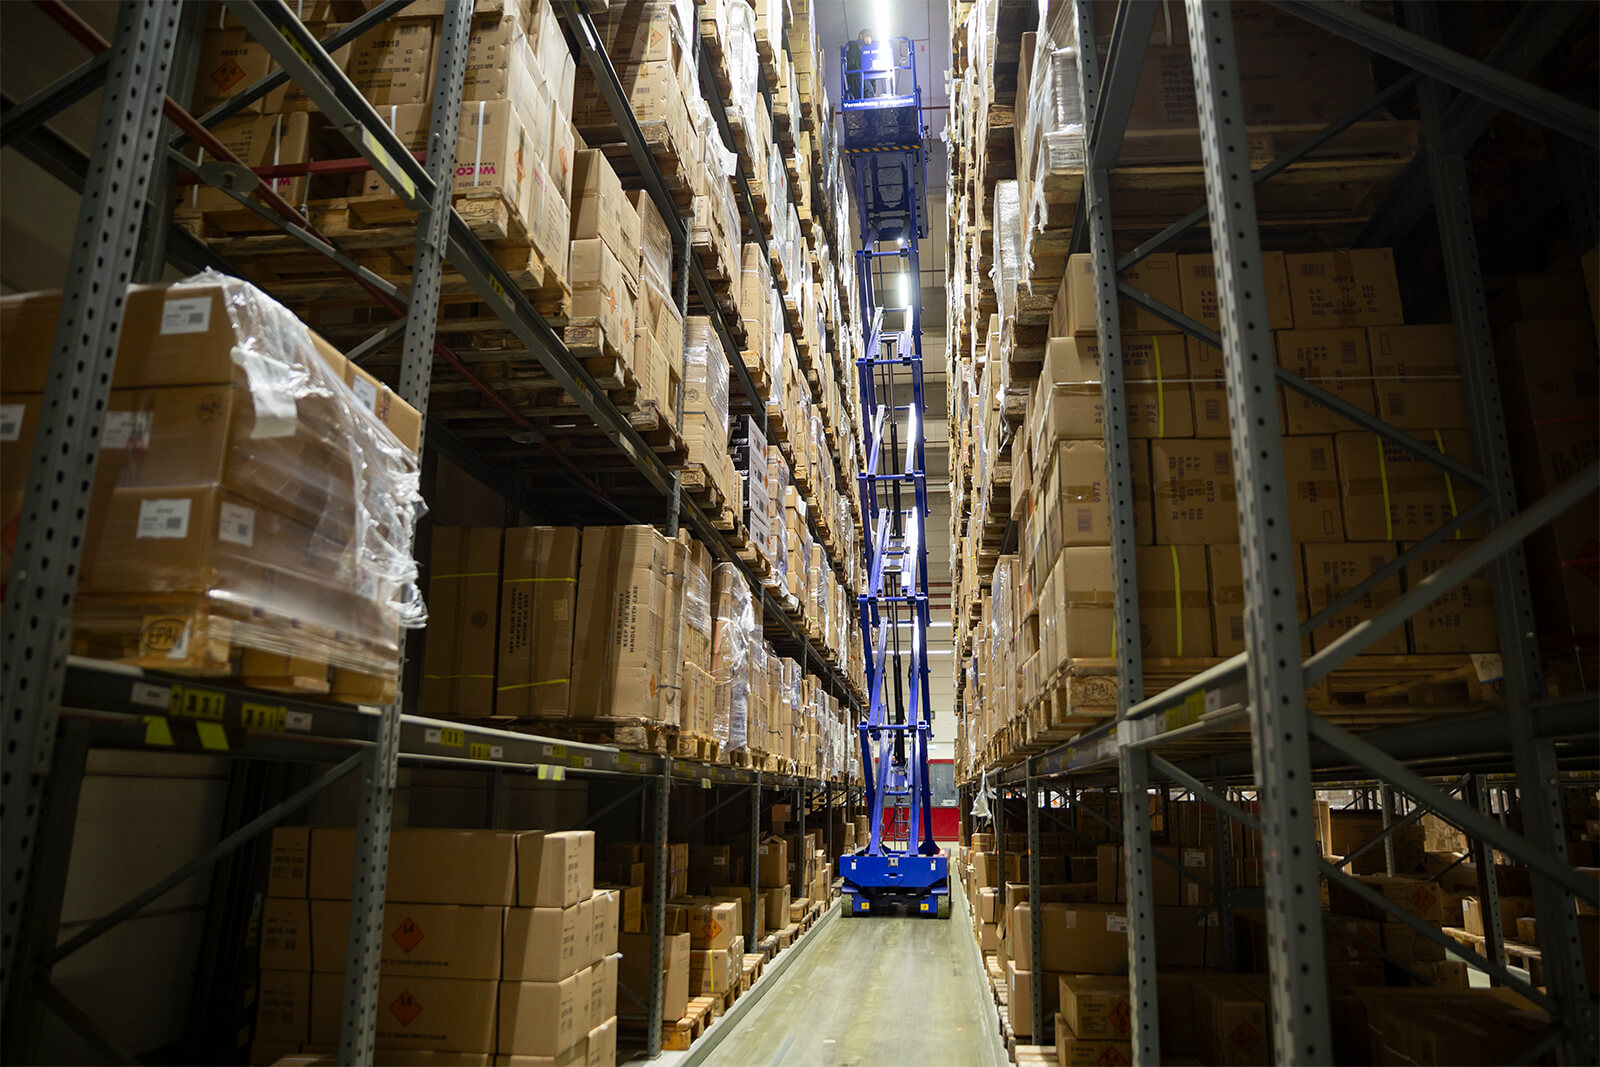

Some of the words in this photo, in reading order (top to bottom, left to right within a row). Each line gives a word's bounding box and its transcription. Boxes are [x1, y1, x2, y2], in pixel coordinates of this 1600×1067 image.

[1092, 481, 1101, 502] 0972
[1206, 480, 1215, 502] 0972
[523, 610, 528, 620] NO
[617, 618, 623, 629] NO
